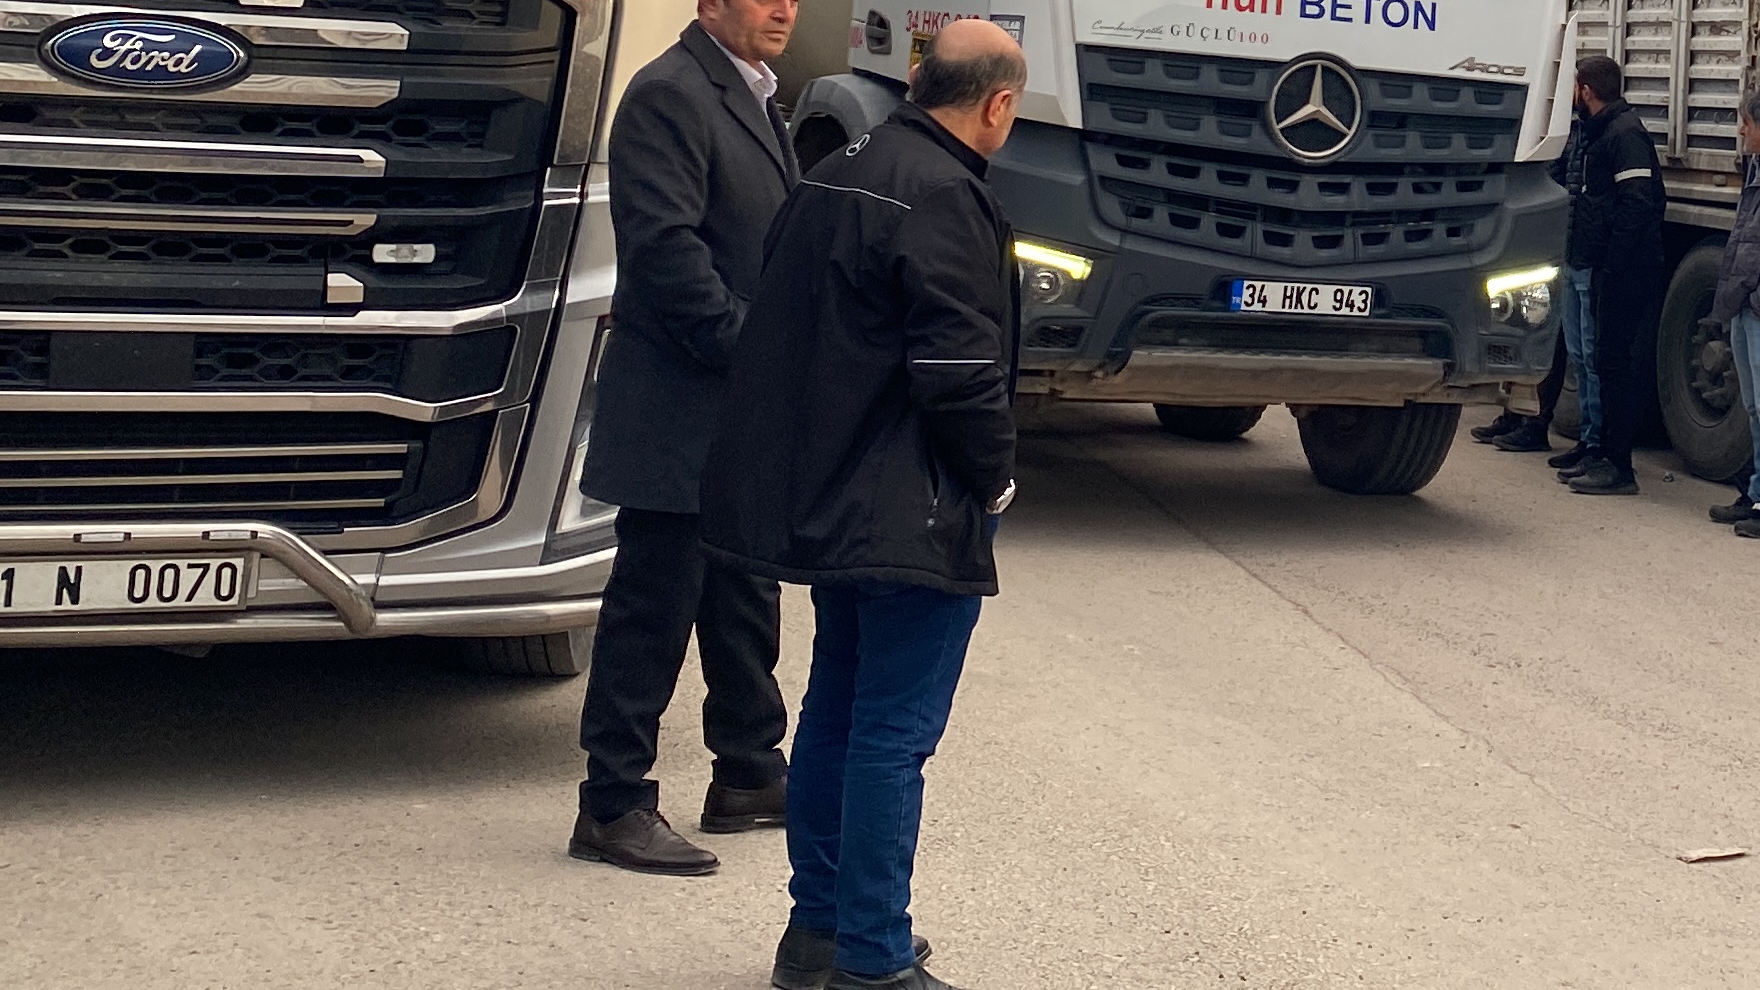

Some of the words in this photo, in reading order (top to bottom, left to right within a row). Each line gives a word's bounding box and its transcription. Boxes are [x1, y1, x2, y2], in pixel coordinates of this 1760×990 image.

[905, 10, 919, 32] 34
[90, 29, 203, 73] Ford
[1243, 283, 1268, 309] 34
[1281, 285, 1320, 311] HKC
[1332, 288, 1370, 313] 943
[54, 565, 83, 607] N
[127, 562, 239, 605] 0070
